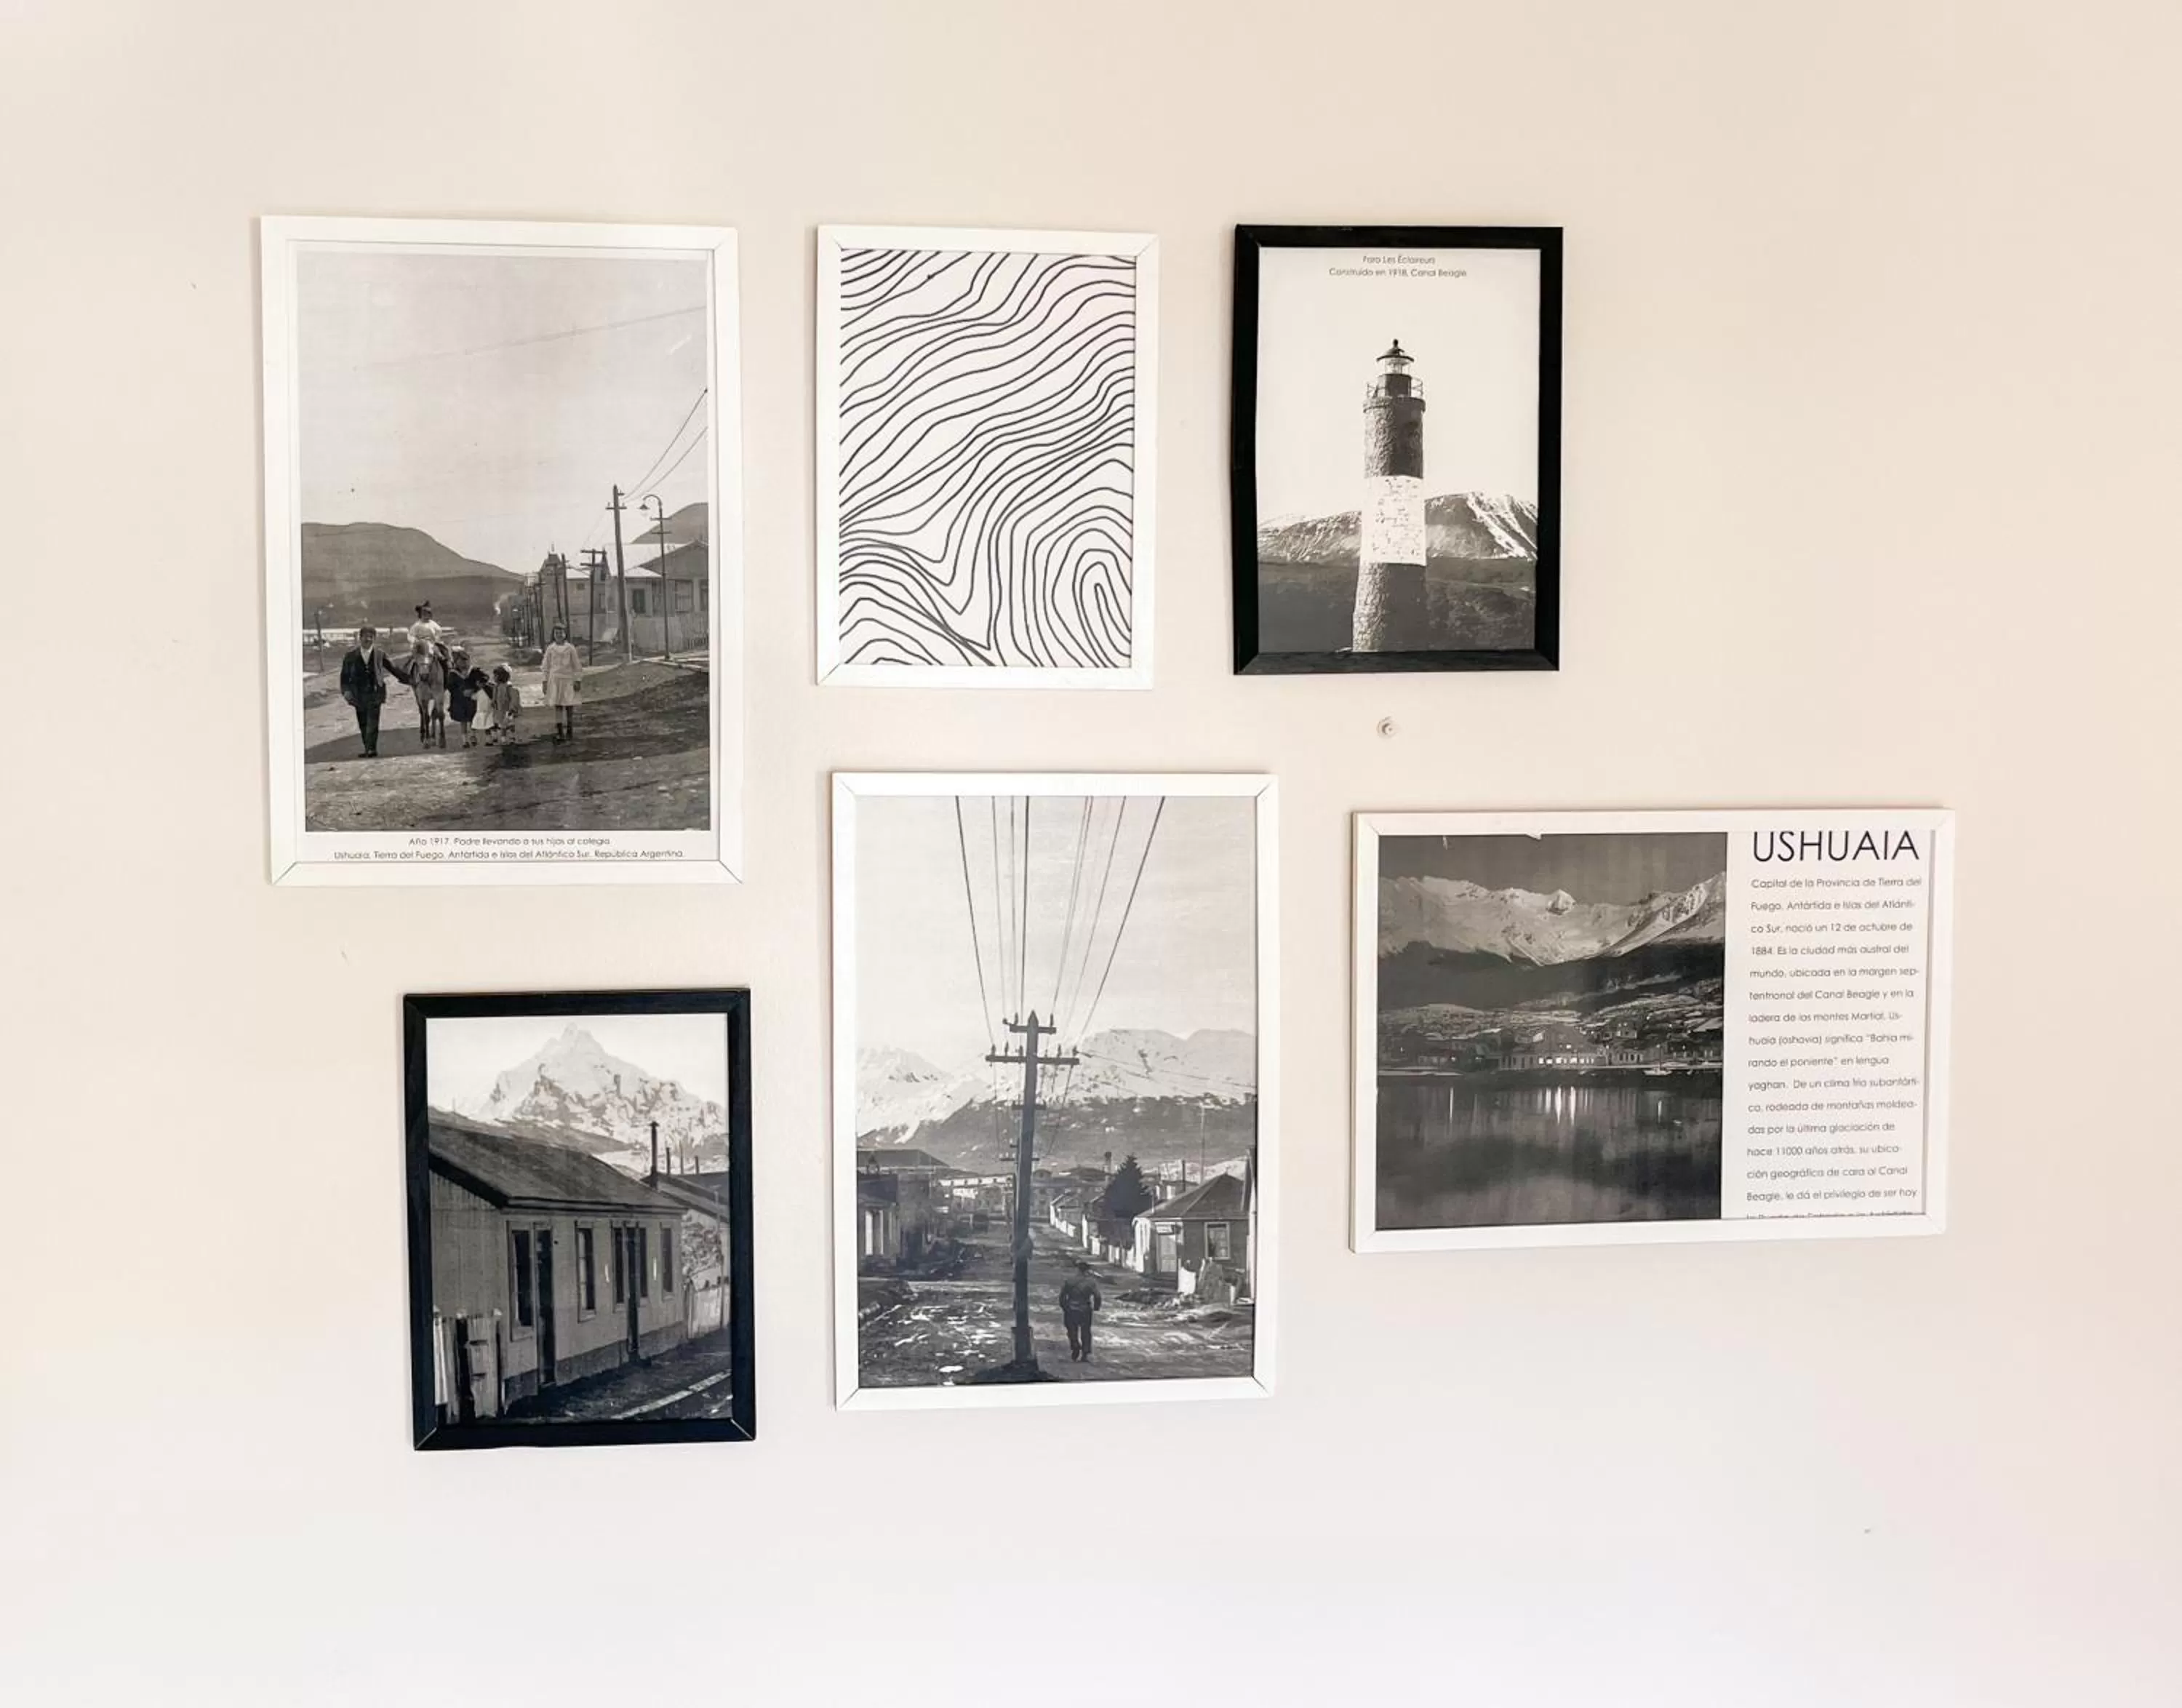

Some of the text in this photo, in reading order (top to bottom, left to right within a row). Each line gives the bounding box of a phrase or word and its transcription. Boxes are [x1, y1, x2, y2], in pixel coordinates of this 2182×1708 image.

[1362, 256, 1381, 264] Faro
[1382, 256, 1396, 264] Les
[1410, 268, 1436, 276] Canal
[1437, 269, 1467, 278] Beagle
[453, 838, 481, 846] Padre
[1753, 830, 1920, 862] USHUAIA
[373, 851, 398, 859] Tierra
[399, 851, 414, 859] del
[519, 850, 534, 859] del
[1751, 877, 1922, 888] Capital de la Provincia de Tierra del
[1864, 901, 1879, 909] del
[1830, 923, 1841, 931] 12
[1858, 922, 1898, 931] octubre
[1899, 922, 1913, 931] de
[1777, 946, 1788, 954] Es
[1789, 946, 1798, 954] la
[1799, 946, 1835, 954] ciudad
[1837, 946, 1858, 954] más
[1859, 945, 1891, 954] austral
[1893, 945, 1910, 954] del
[1789, 969, 1831, 978] ubicada
[1833, 969, 1846, 977] en
[1858, 968, 1897, 978] margen
[1899, 968, 1920, 976] sep-
[1797, 991, 1813, 999] del
[1815, 990, 1845, 999] Canal
[1846, 989, 1880, 999] Beagle
[1882, 991, 1888, 999] y
[1890, 990, 1903, 998] en
[1904, 989, 1914, 997] la
[1748, 1013, 1781, 1023] ladera
[1783, 1014, 1797, 1022] de
[1813, 1013, 1850, 1021] montes
[1824, 1034, 1863, 1045] significa
[1748, 1059, 1778, 1067] rando
[1855, 1056, 1890, 1066] lengua
[1792, 1080, 1807, 1088] De
[1823, 1080, 1850, 1088] clima
[1765, 1103, 1809, 1112] rodeada
[1810, 1102, 1824, 1110] de
[1876, 1100, 1918, 1109] moldea-
[1747, 1125, 1765, 1135] das
[1767, 1126, 1783, 1135] por
[1786, 1125, 1795, 1133] la
[1829, 1122, 1880, 1134] glaciación
[1882, 1123, 1895, 1131] de
[1746, 1148, 1773, 1156] hace
[1775, 1146, 1802, 1156] 11000
[1805, 1146, 1829, 1155] años
[1746, 1170, 1768, 1179] ción
[1770, 1168, 1825, 1180] geográfica
[1826, 1168, 1839, 1176] de
[1866, 1168, 1877, 1176] al
[1877, 1166, 1908, 1176] Canal
[1786, 1192, 1794, 1200] le
[1813, 1190, 1822, 1199] el
[1823, 1189, 1866, 1200] privilegio
[1868, 1190, 1882, 1198] de
[1883, 1190, 1896, 1198] ser
[1898, 1188, 1917, 1199] hoy
